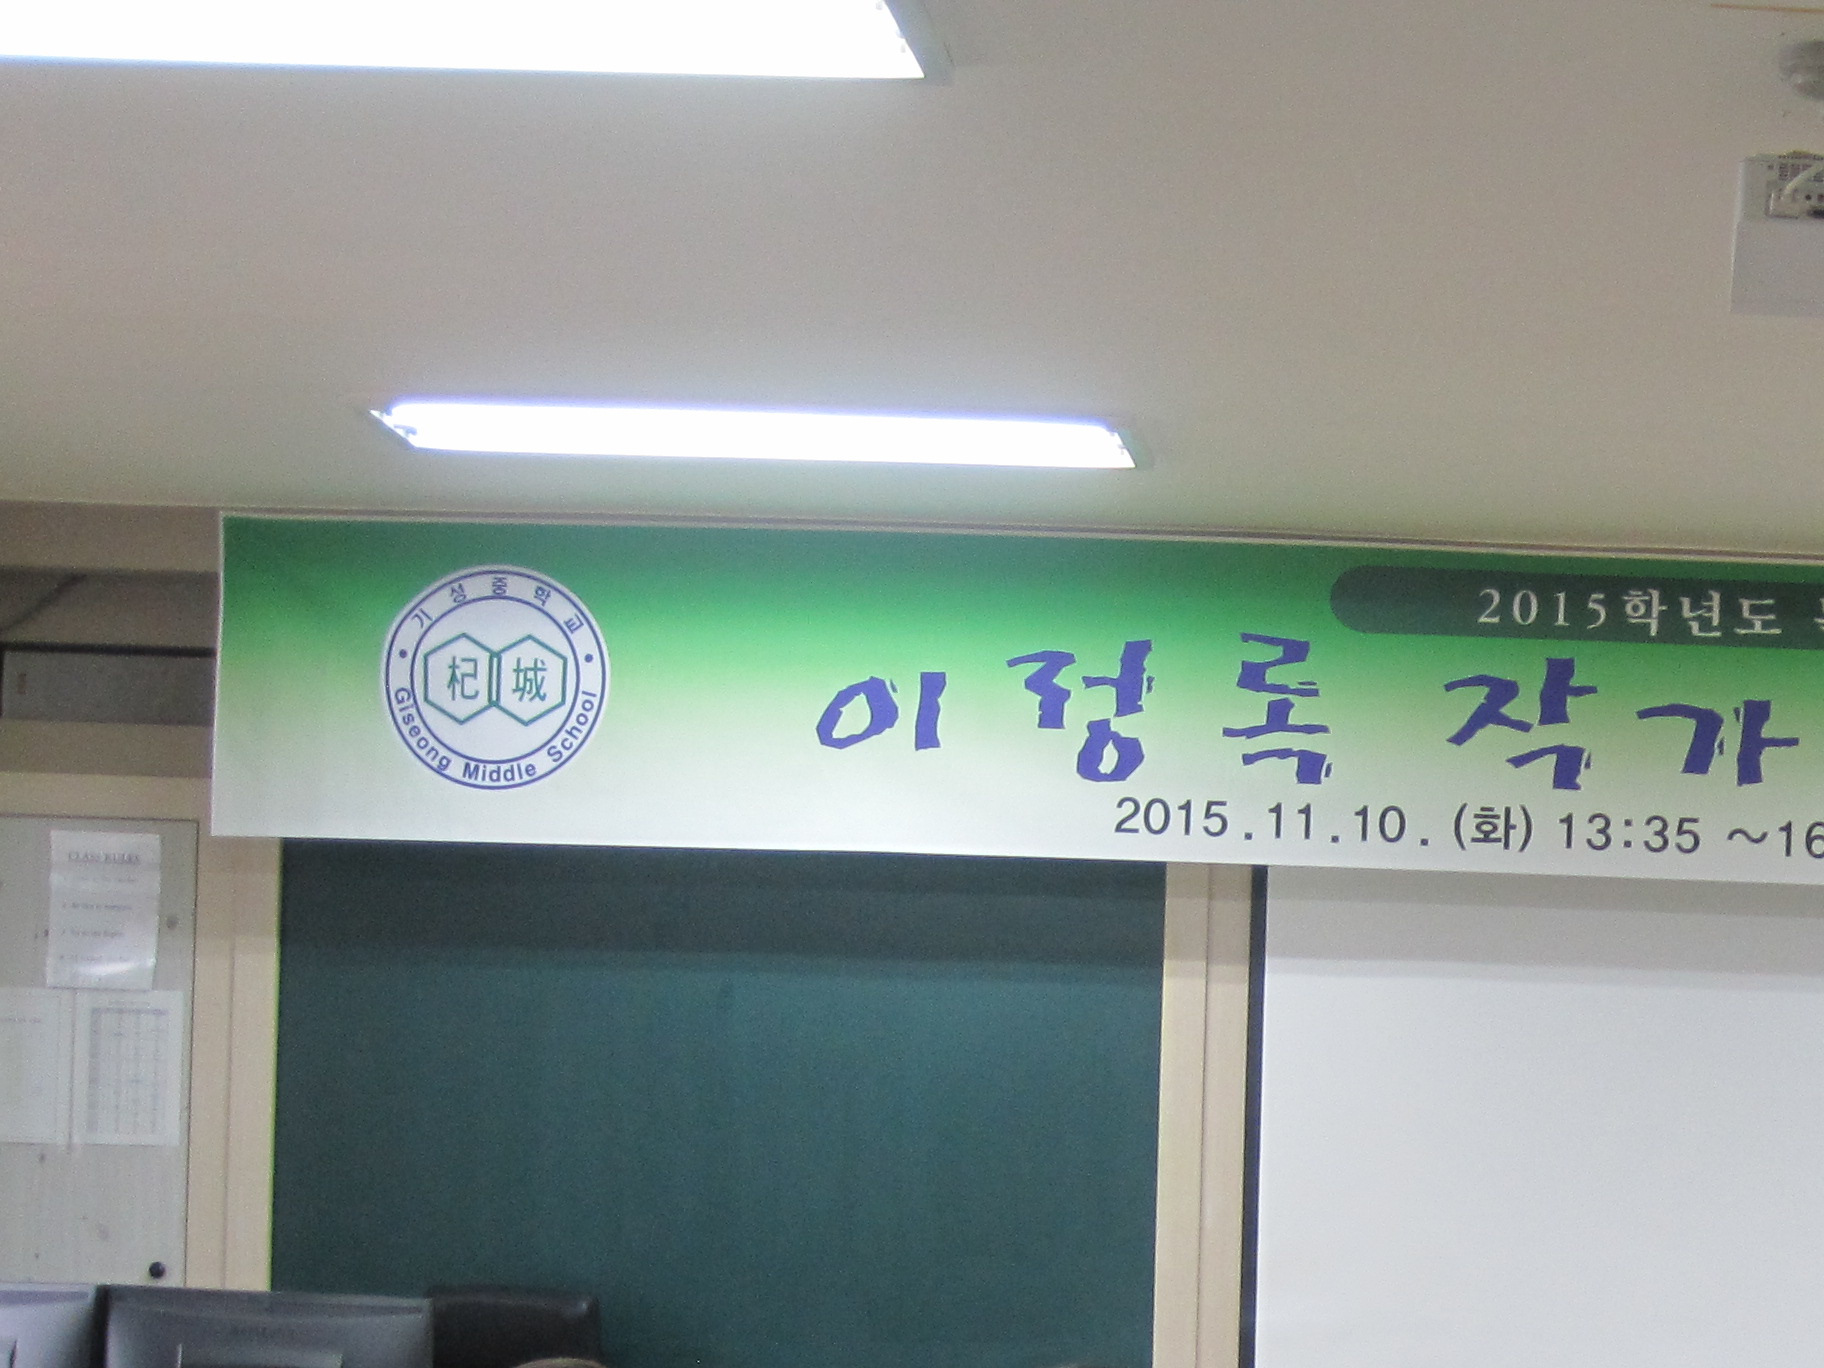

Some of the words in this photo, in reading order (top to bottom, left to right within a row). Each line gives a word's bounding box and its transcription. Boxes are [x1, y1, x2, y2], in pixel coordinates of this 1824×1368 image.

[411, 576, 585, 634] 기성중학교
[1476, 587, 1783, 639] 2015학년도
[394, 687, 453, 772] Giseong
[462, 761, 537, 783] Middle
[546, 690, 598, 763] School
[816, 632, 1333, 785] 이정록
[1452, 802, 1535, 854] (화)
[1557, 811, 1702, 855] 13:35
